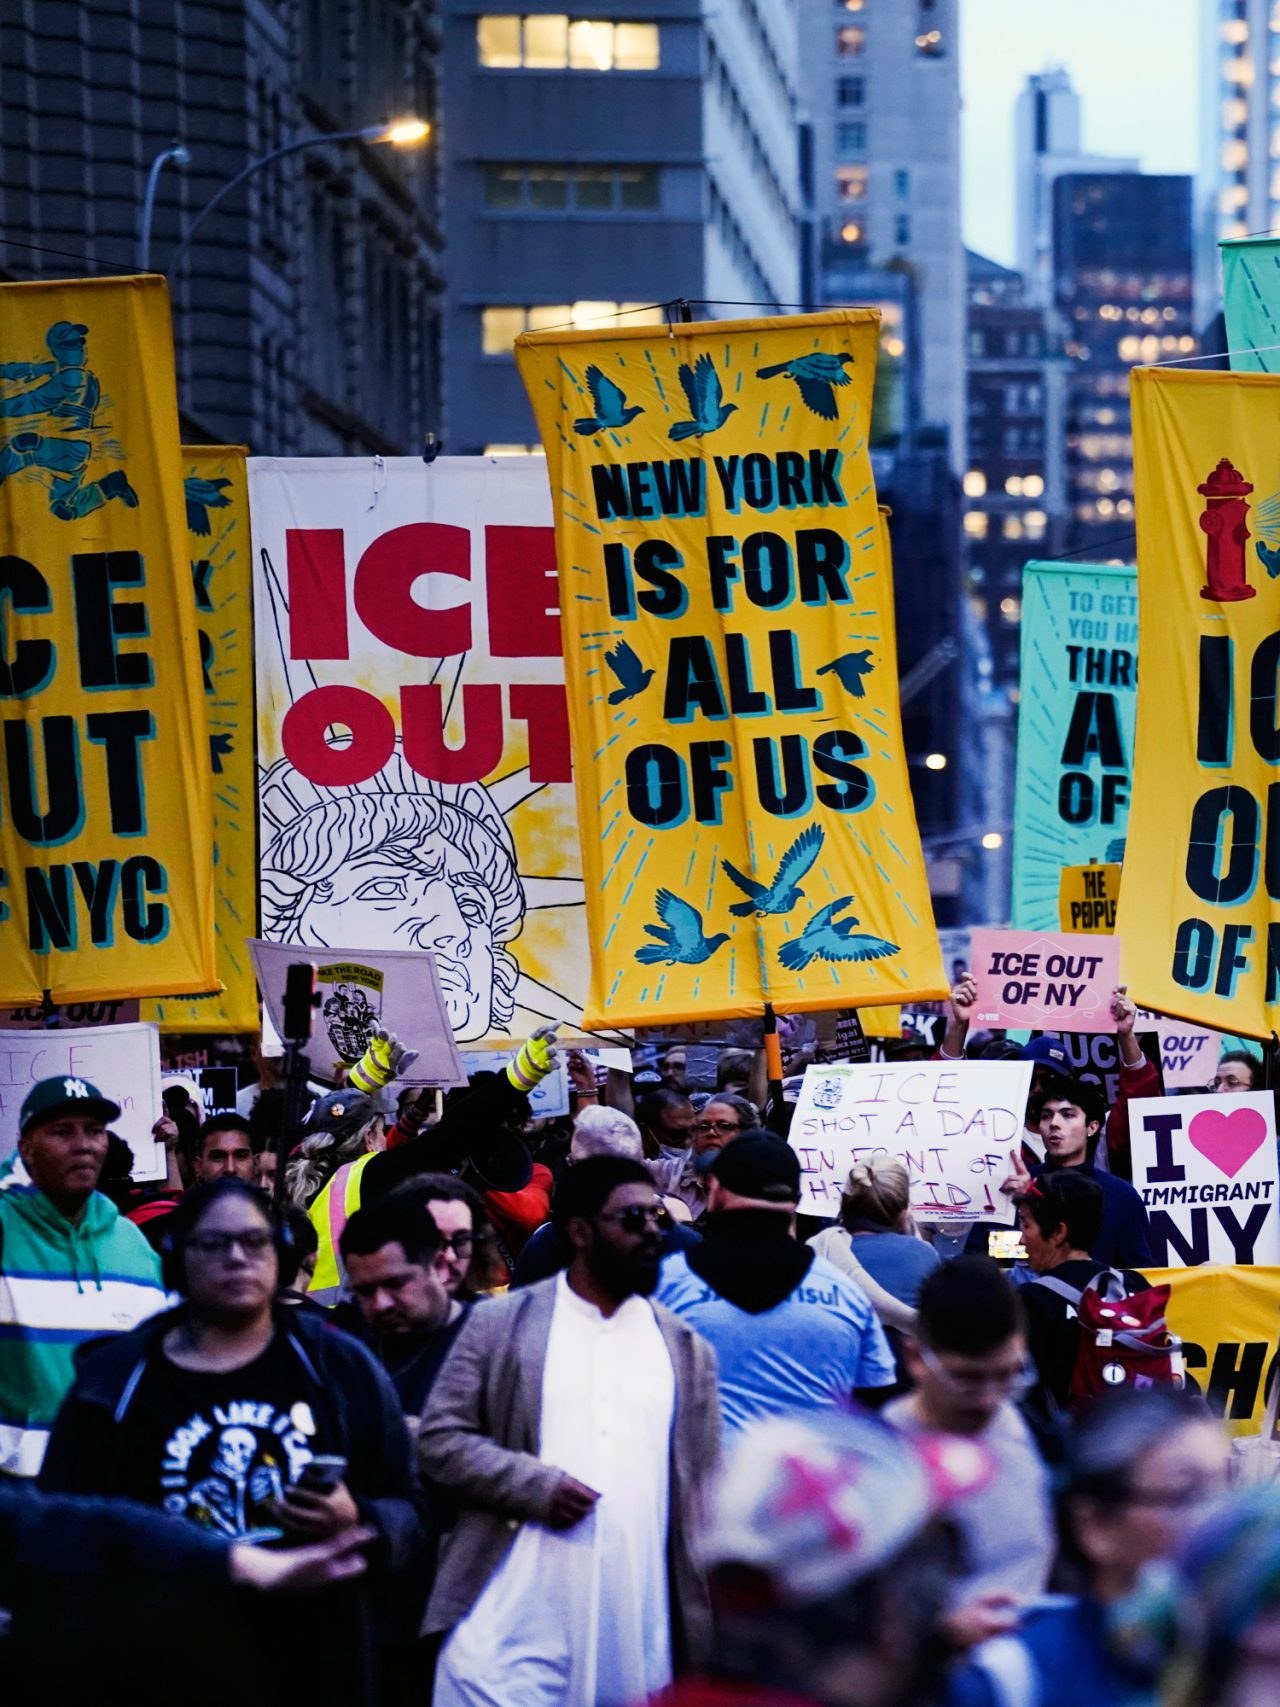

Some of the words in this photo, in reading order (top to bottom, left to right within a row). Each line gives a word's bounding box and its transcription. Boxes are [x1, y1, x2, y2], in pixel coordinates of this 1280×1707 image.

[591, 457, 706, 522] NEW
[713, 448, 848, 516] YORK
[286, 522, 563, 661] ICE
[603, 538, 690, 622] IS
[706, 527, 854, 613] FOR
[1068, 592, 1094, 613] TO
[0, 551, 155, 694] CE
[1068, 618, 1108, 641] YOU
[663, 628, 824, 725] ALL
[1066, 645, 1138, 688] THR
[281, 684, 573, 787] OUT
[1060, 692, 1131, 768] A
[0, 709, 157, 848] UT
[624, 739, 734, 829] OF
[752, 730, 877, 820] US
[1058, 771, 1131, 828] OF
[25, 855, 171, 955] NYC
[1082, 871, 1107, 899] THE
[353, 966, 381, 981] ROAD
[988, 952, 1040, 977] ICE
[1046, 954, 1103, 979] OUT
[1172, 917, 1256, 1001] OF
[1002, 981, 1040, 1005] OF
[1044, 983, 1087, 1006] NY
[1163, 1035, 1209, 1052] OUT
[855, 1072, 961, 1105] ICE
[800, 1113, 879, 1137] SHOT
[896, 1111, 918, 1137] A
[937, 1107, 1018, 1142] DAD
[1142, 1113, 1186, 1184] I
[799, 1148, 836, 1173] IN
[1141, 1181, 1275, 1206] IMMIGRANT
[1148, 1203, 1272, 1268] NY
